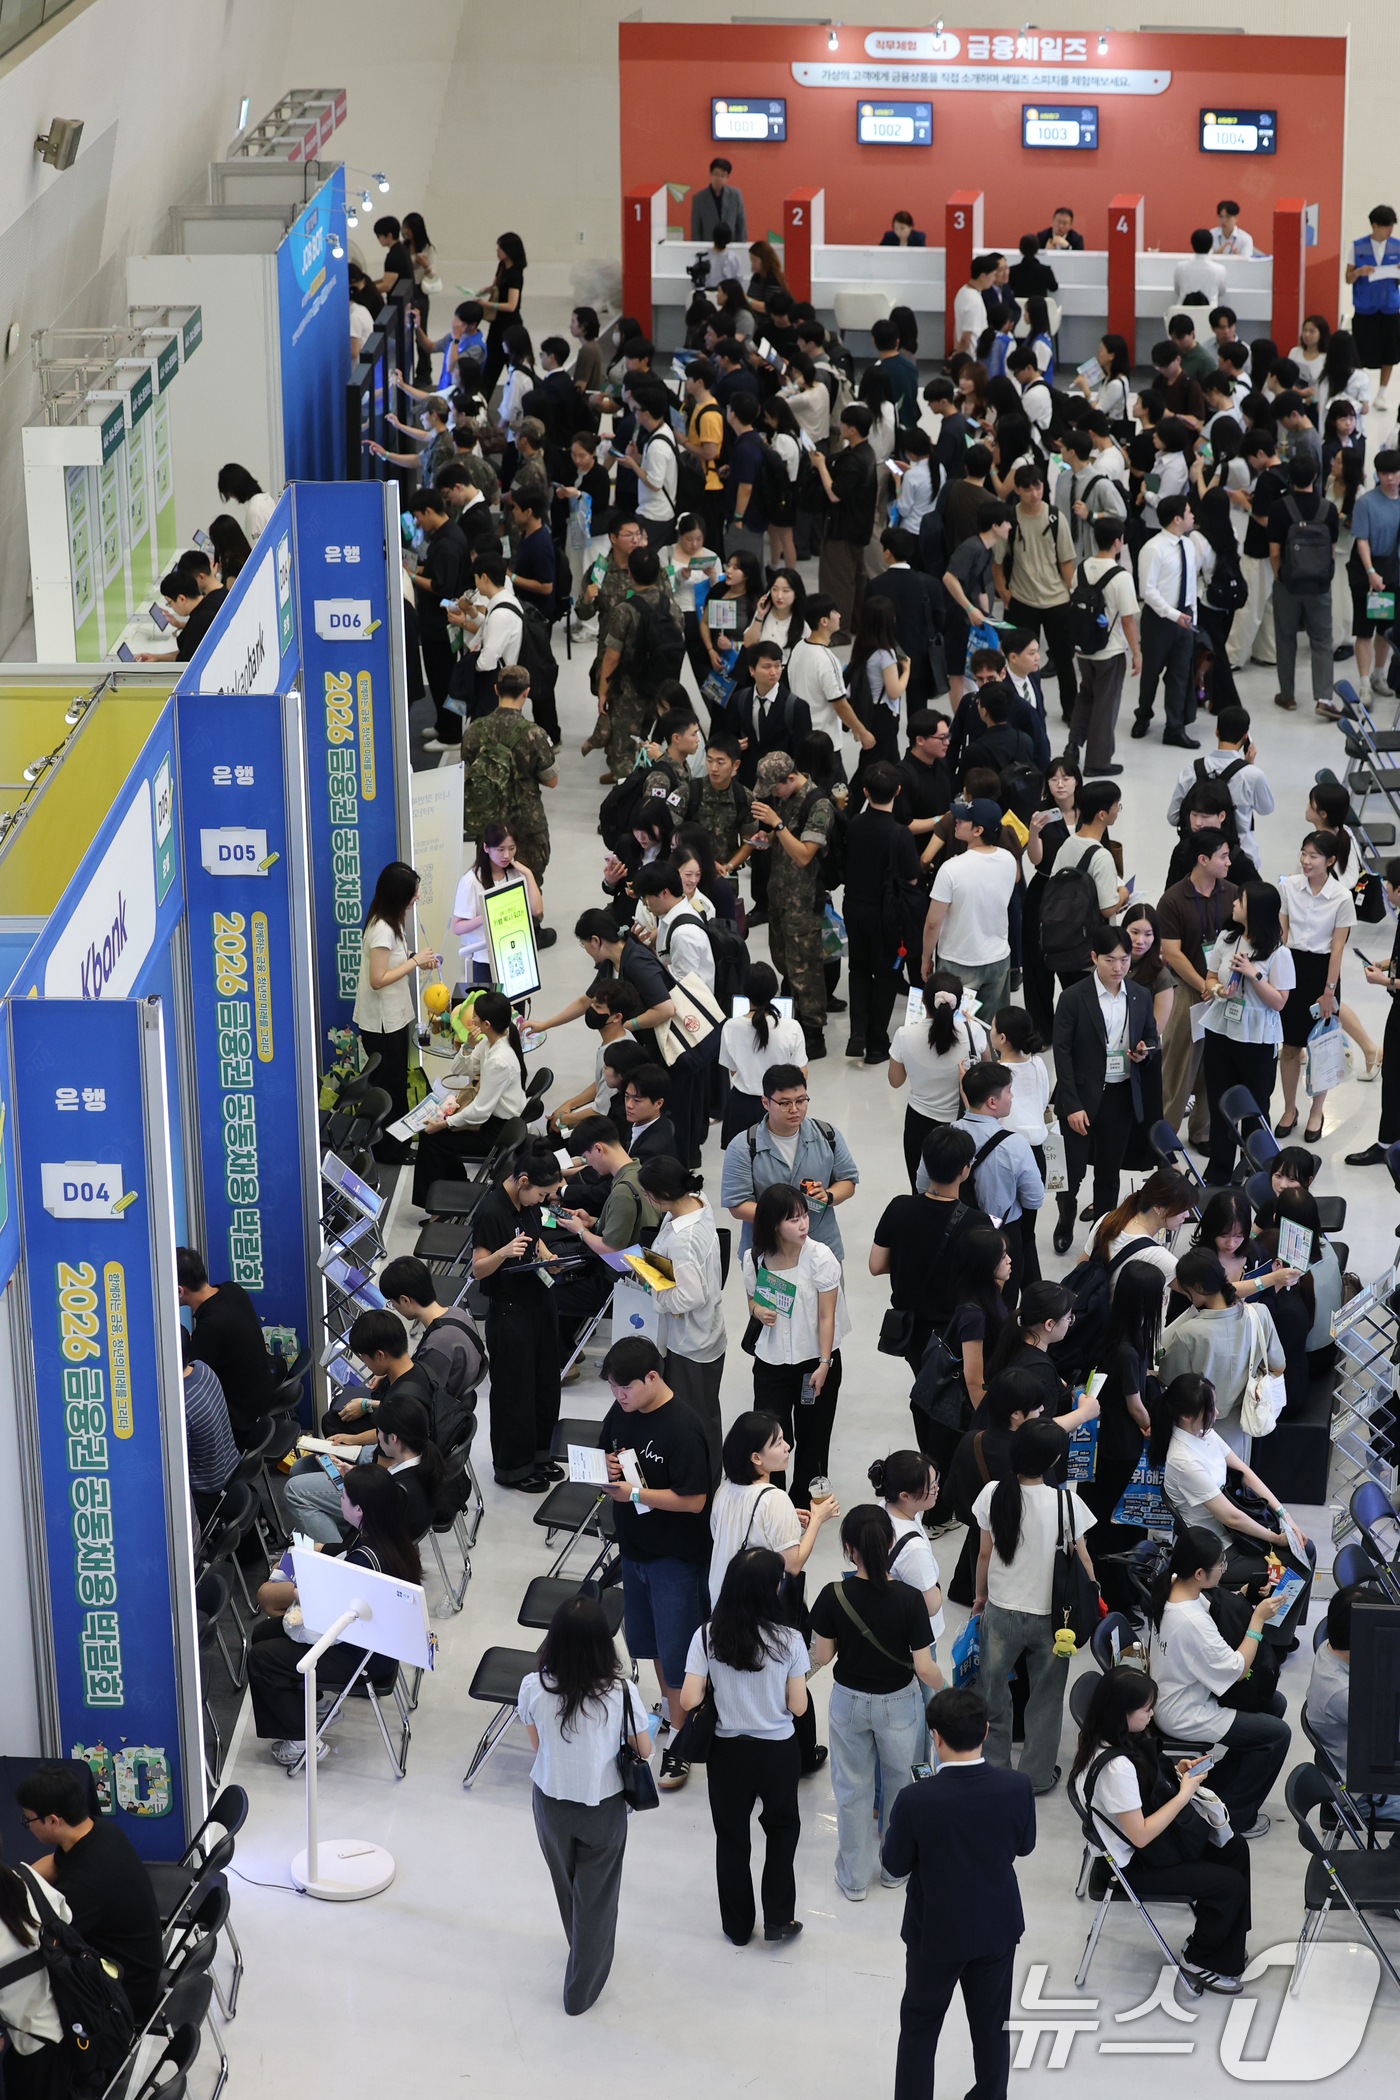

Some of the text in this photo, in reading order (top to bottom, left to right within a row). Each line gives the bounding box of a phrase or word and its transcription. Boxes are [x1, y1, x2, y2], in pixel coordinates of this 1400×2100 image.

[822, 69, 850, 81] 가상의
[852, 70, 889, 82] 고객에게
[891, 71, 938, 83] 금융상품을
[940, 72, 960, 83] 직접
[1001, 74, 1029, 85] 세일즈
[1031, 75, 1069, 86] 스피치를
[729, 120, 755, 132] 1001
[873, 123, 926, 138] 1002 2
[1038, 127, 1091, 143] 1003 3
[1215, 131, 1270, 147] 1004 4
[634, 203, 641, 221] 1
[792, 207, 803, 225] 2
[954, 211, 965, 229] 3
[1116, 215, 1128, 233] 4
[325, 545, 361, 563] 은행
[329, 613, 361, 628] D06
[359, 678, 374, 793] 함께하는 금융, 청년의 미래를 그리다
[212, 765, 255, 786] 은행
[324, 671, 363, 1000] 2026 금융권 공동채용 박람회
[218, 844, 256, 861] D05
[81, 890, 128, 1000] Kbank
[255, 921, 271, 1053] 함께하는 금융, 청년의 미래를 그리다
[55, 1087, 107, 1112] 은행
[213, 911, 264, 1290] 2026 금융권 공동채용 박람회
[63, 1182, 110, 1202] D04
[107, 1272, 129, 1430] 함께하는 금융, 청년의 미래를 그리다
[57, 1262, 124, 1709] 2026 금융권 공동채용 박람회
